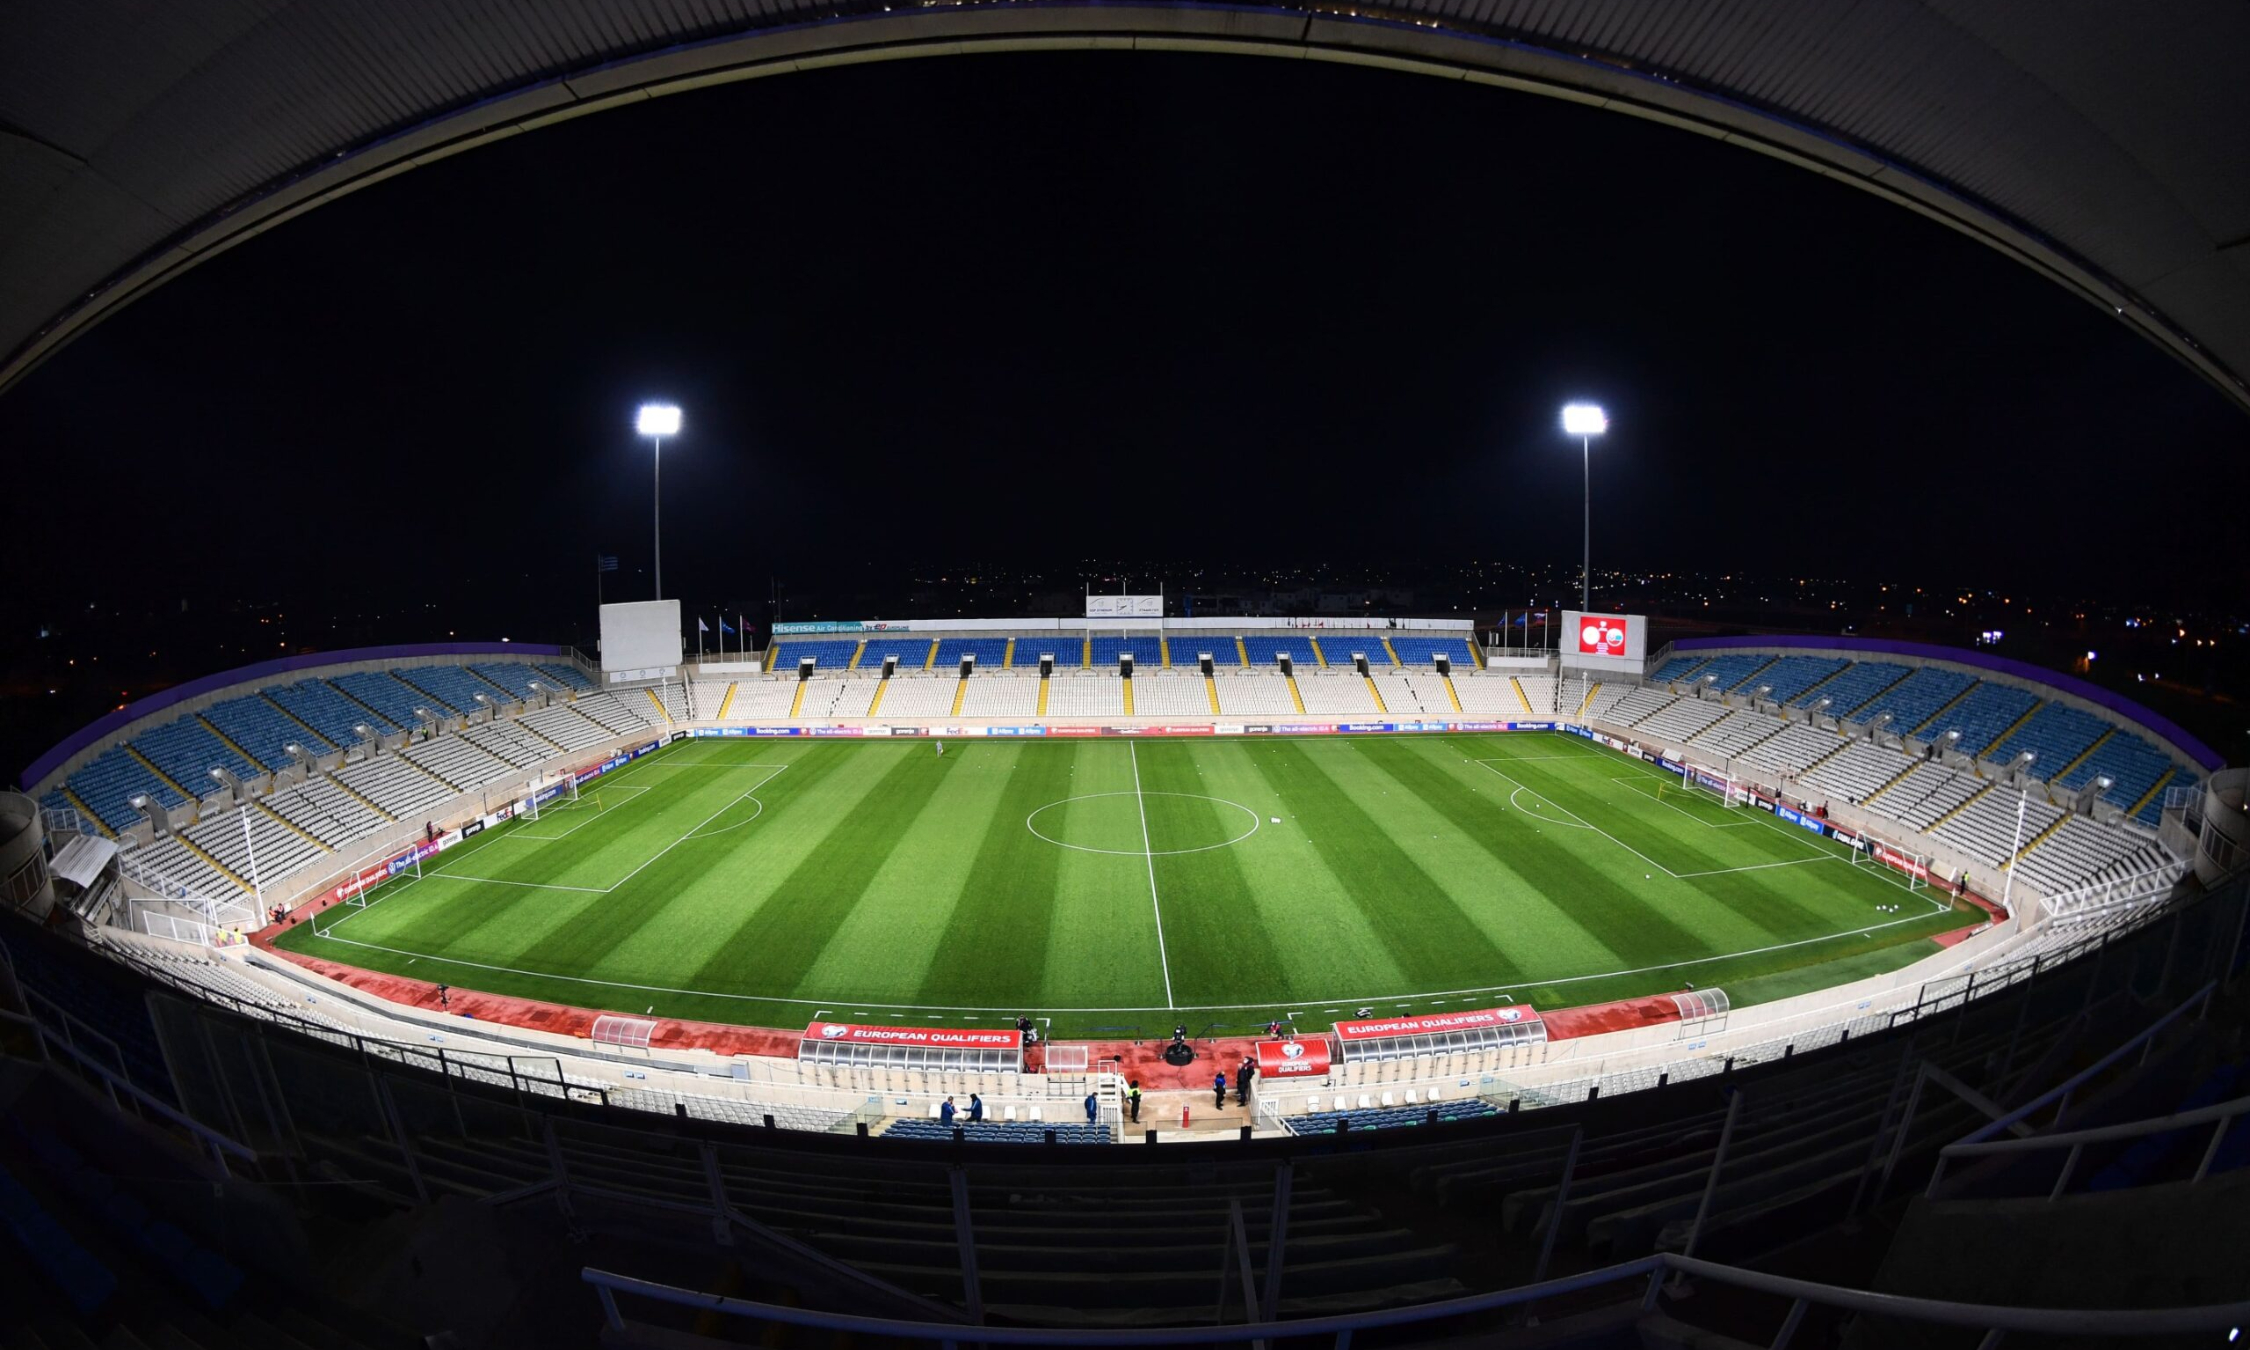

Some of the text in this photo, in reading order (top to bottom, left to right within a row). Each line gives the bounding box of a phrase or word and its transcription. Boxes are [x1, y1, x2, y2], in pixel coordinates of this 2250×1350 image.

[772, 624, 816, 633] Hisense
[826, 624, 862, 632] Conditioning
[1662, 760, 1684, 774] Booking.com
[497, 809, 513, 822] FedEx
[1785, 810, 1798, 822] Alipay
[465, 822, 481, 836] gorenje
[1806, 820, 1819, 832] Alipay
[443, 834, 458, 847] gorenje
[396, 860, 405, 870] The
[405, 848, 429, 865] all-electric
[1347, 1014, 1494, 1034] EUROPEAN QUALIFIERS
[854, 1030, 1012, 1043] EUROPEAN QUALIFIERS
[1278, 1065, 1312, 1073] QUALIFIERS
